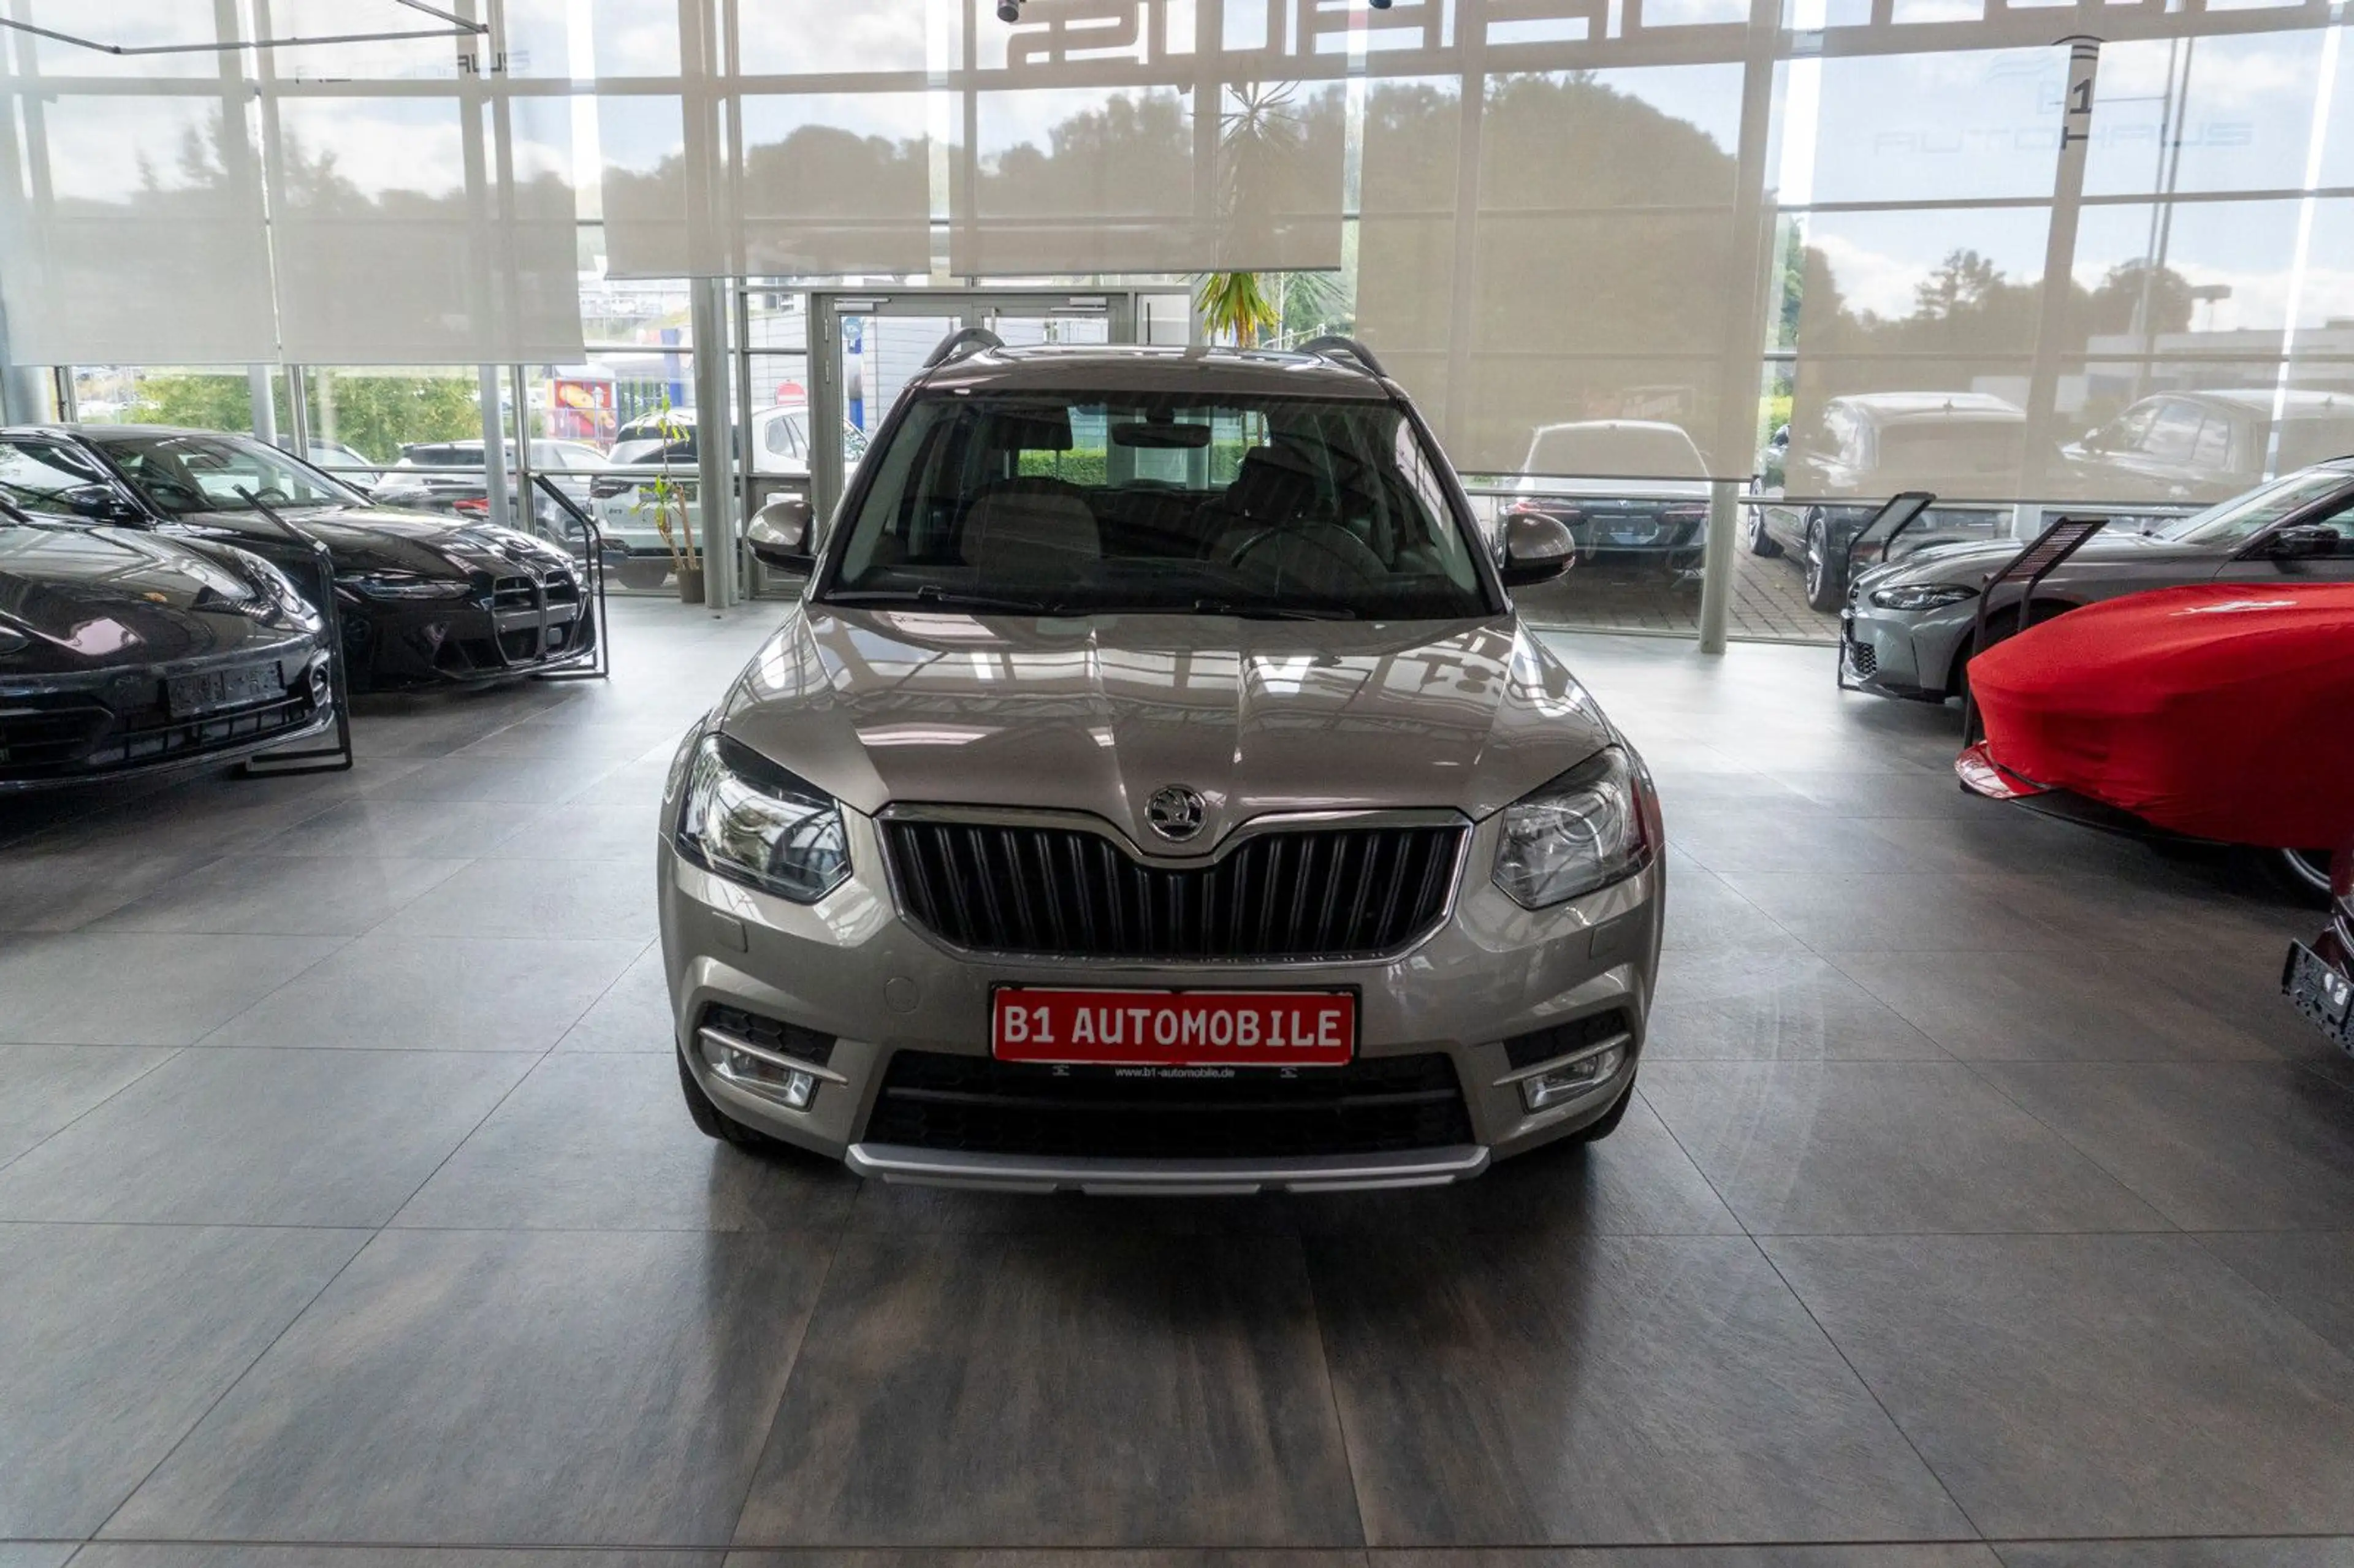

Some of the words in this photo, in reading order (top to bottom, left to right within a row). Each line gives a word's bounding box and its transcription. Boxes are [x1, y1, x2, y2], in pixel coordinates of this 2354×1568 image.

[1004, 1006, 1055, 1043] B1
[1071, 1007, 1343, 1047] AUTOMOBILE
[1114, 1065, 1235, 1078] www.b1-automobile.de
